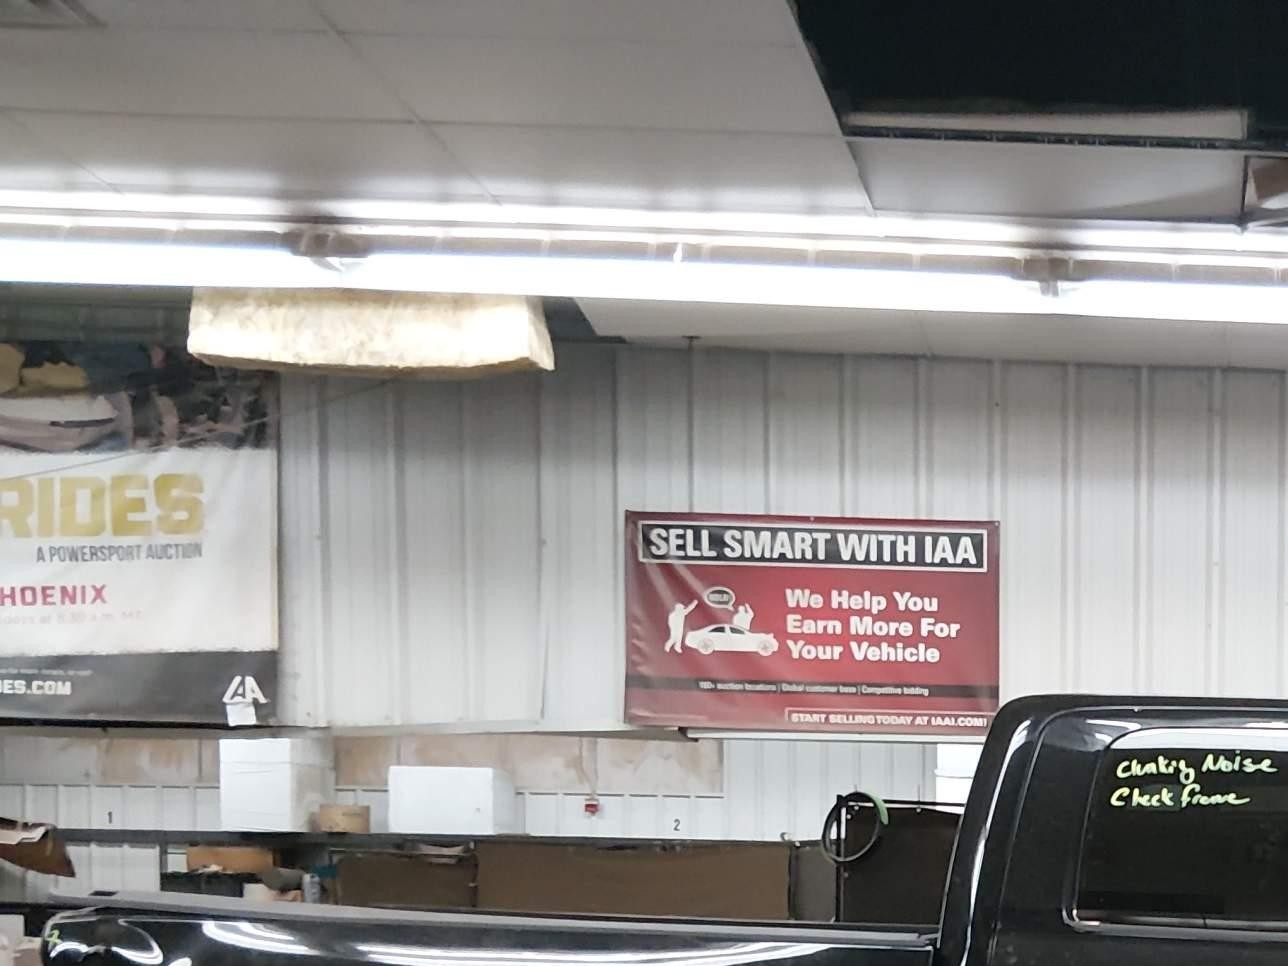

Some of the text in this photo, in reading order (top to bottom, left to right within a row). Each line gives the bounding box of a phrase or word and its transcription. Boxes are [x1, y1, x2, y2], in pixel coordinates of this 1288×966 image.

[36, 542, 203, 563] A POWERSPORT AUCTION
[650, 527, 977, 565] SELL SMART WITH IAA
[786, 588, 938, 614] We Help You
[786, 614, 960, 638] Earn More For
[786, 640, 940, 663] Your Vehicle
[791, 713, 825, 724] START
[829, 714, 875, 725] SELLING
[876, 715, 912, 726] TODAY
[914, 716, 929, 726] AT
[1201, 750, 1278, 773] Noise
[1110, 787, 1175, 807] Check
[107, 811, 113, 825] 1
[673, 818, 681, 831] 2
